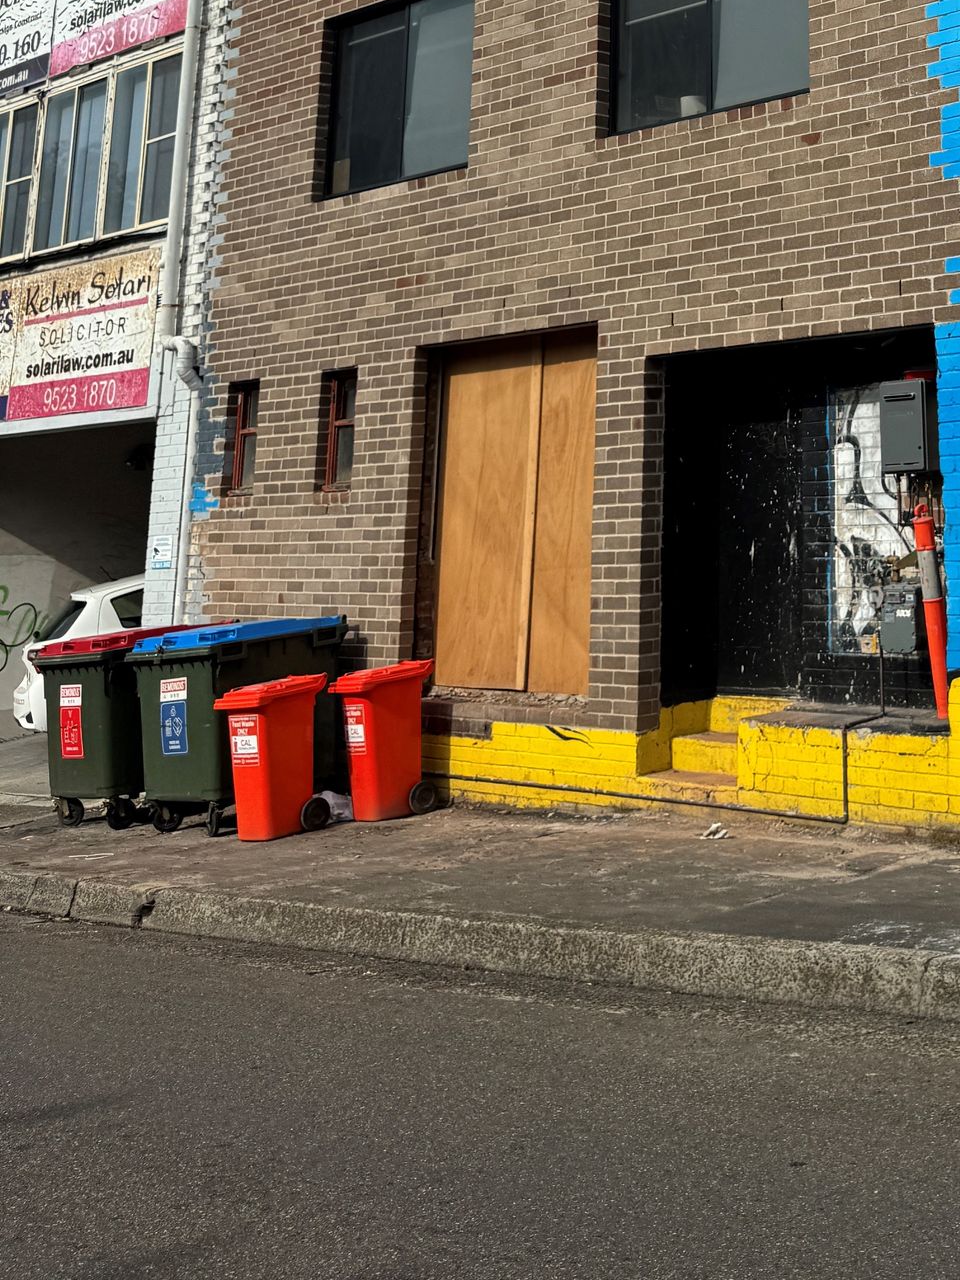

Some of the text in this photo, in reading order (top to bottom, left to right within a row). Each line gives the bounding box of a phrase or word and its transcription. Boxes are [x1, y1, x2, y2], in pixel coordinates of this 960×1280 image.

[13, 30, 41, 61] 160
[79, 9, 162, 62] 9523 1870
[25, 280, 81, 317] Kelvin
[39, 316, 126, 348] SOLICITOR
[26, 348, 135, 379] solarilaw.com.au
[43, 378, 117, 412] 9523 1870
